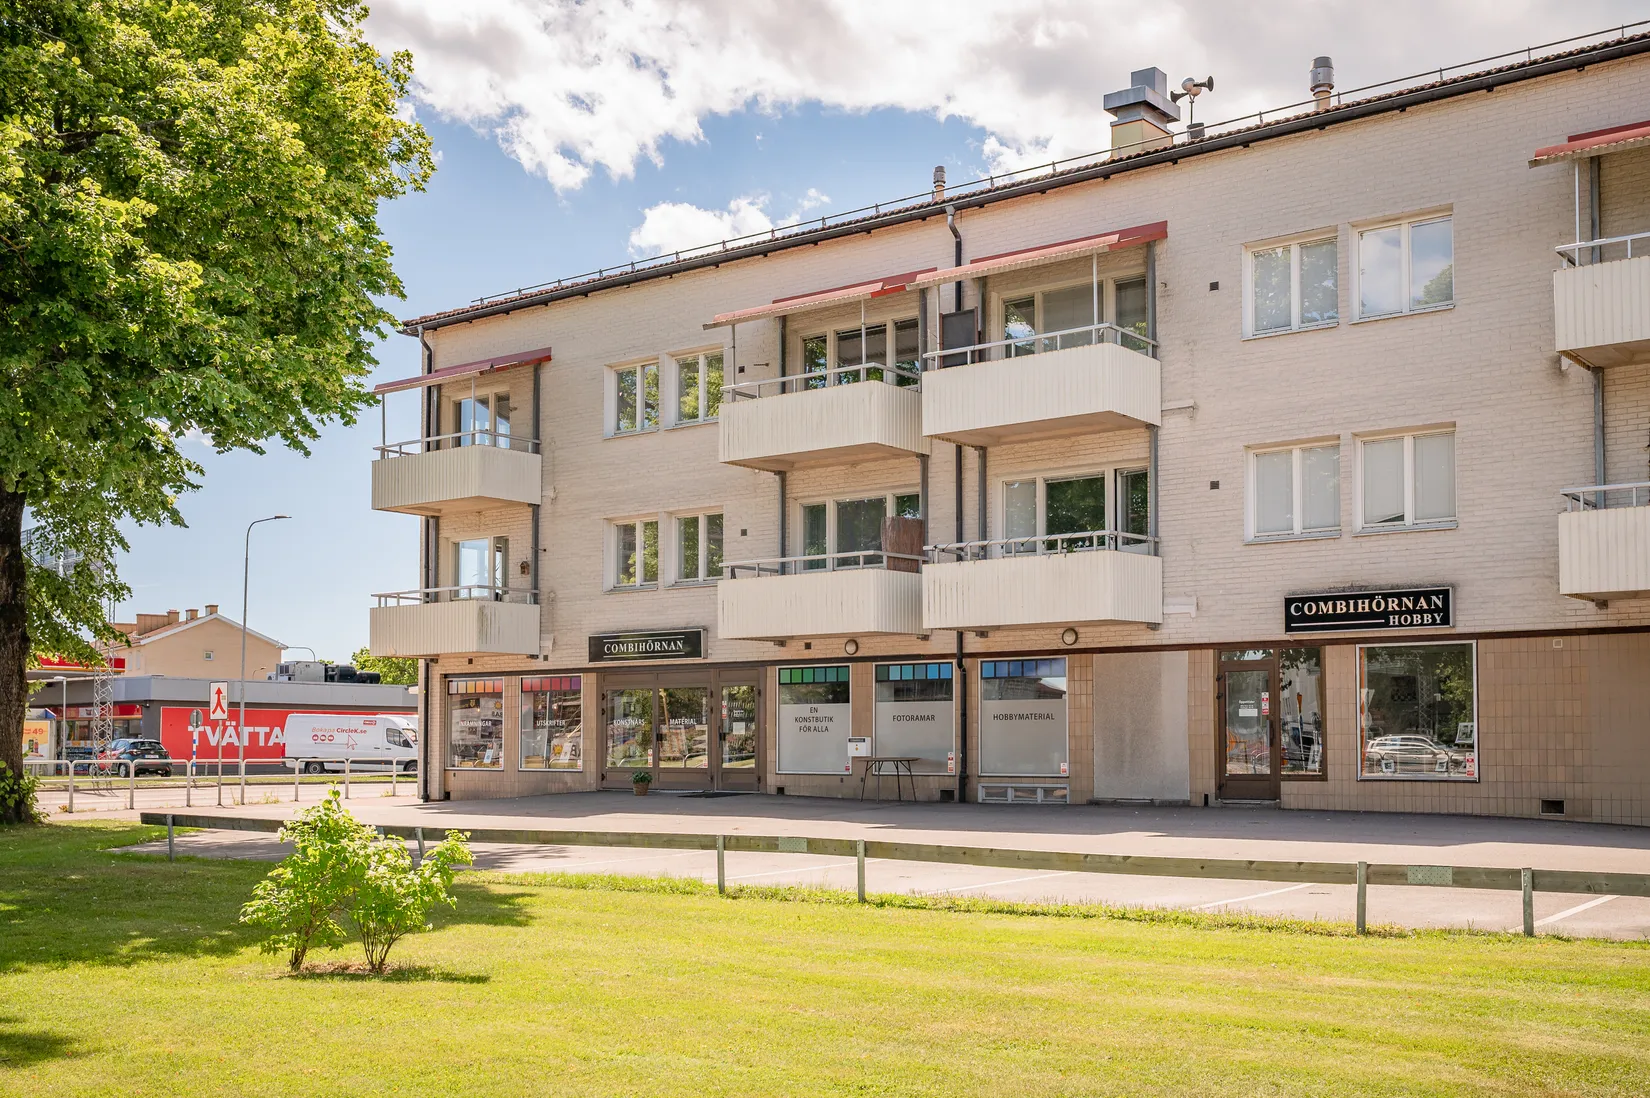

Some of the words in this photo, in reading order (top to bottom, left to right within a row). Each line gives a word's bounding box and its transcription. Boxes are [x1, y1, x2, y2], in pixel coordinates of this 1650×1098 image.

[1290, 595, 1443, 616] COMBIHÖRNAN
[1388, 613, 1443, 626] HOBBY
[604, 639, 684, 654] COMBIHÖRNAN
[809, 706, 818, 714] EN
[892, 714, 936, 722] FOTORAMAR
[992, 712, 1055, 721] HOBBYMATERIAL
[536, 719, 566, 727] UTSKRIFTER
[669, 717, 697, 725] MATERIAL
[336, 727, 367, 735] CircleK.se
[799, 725, 812, 733] FÖR
[187, 721, 285, 746] TVÄTTA
